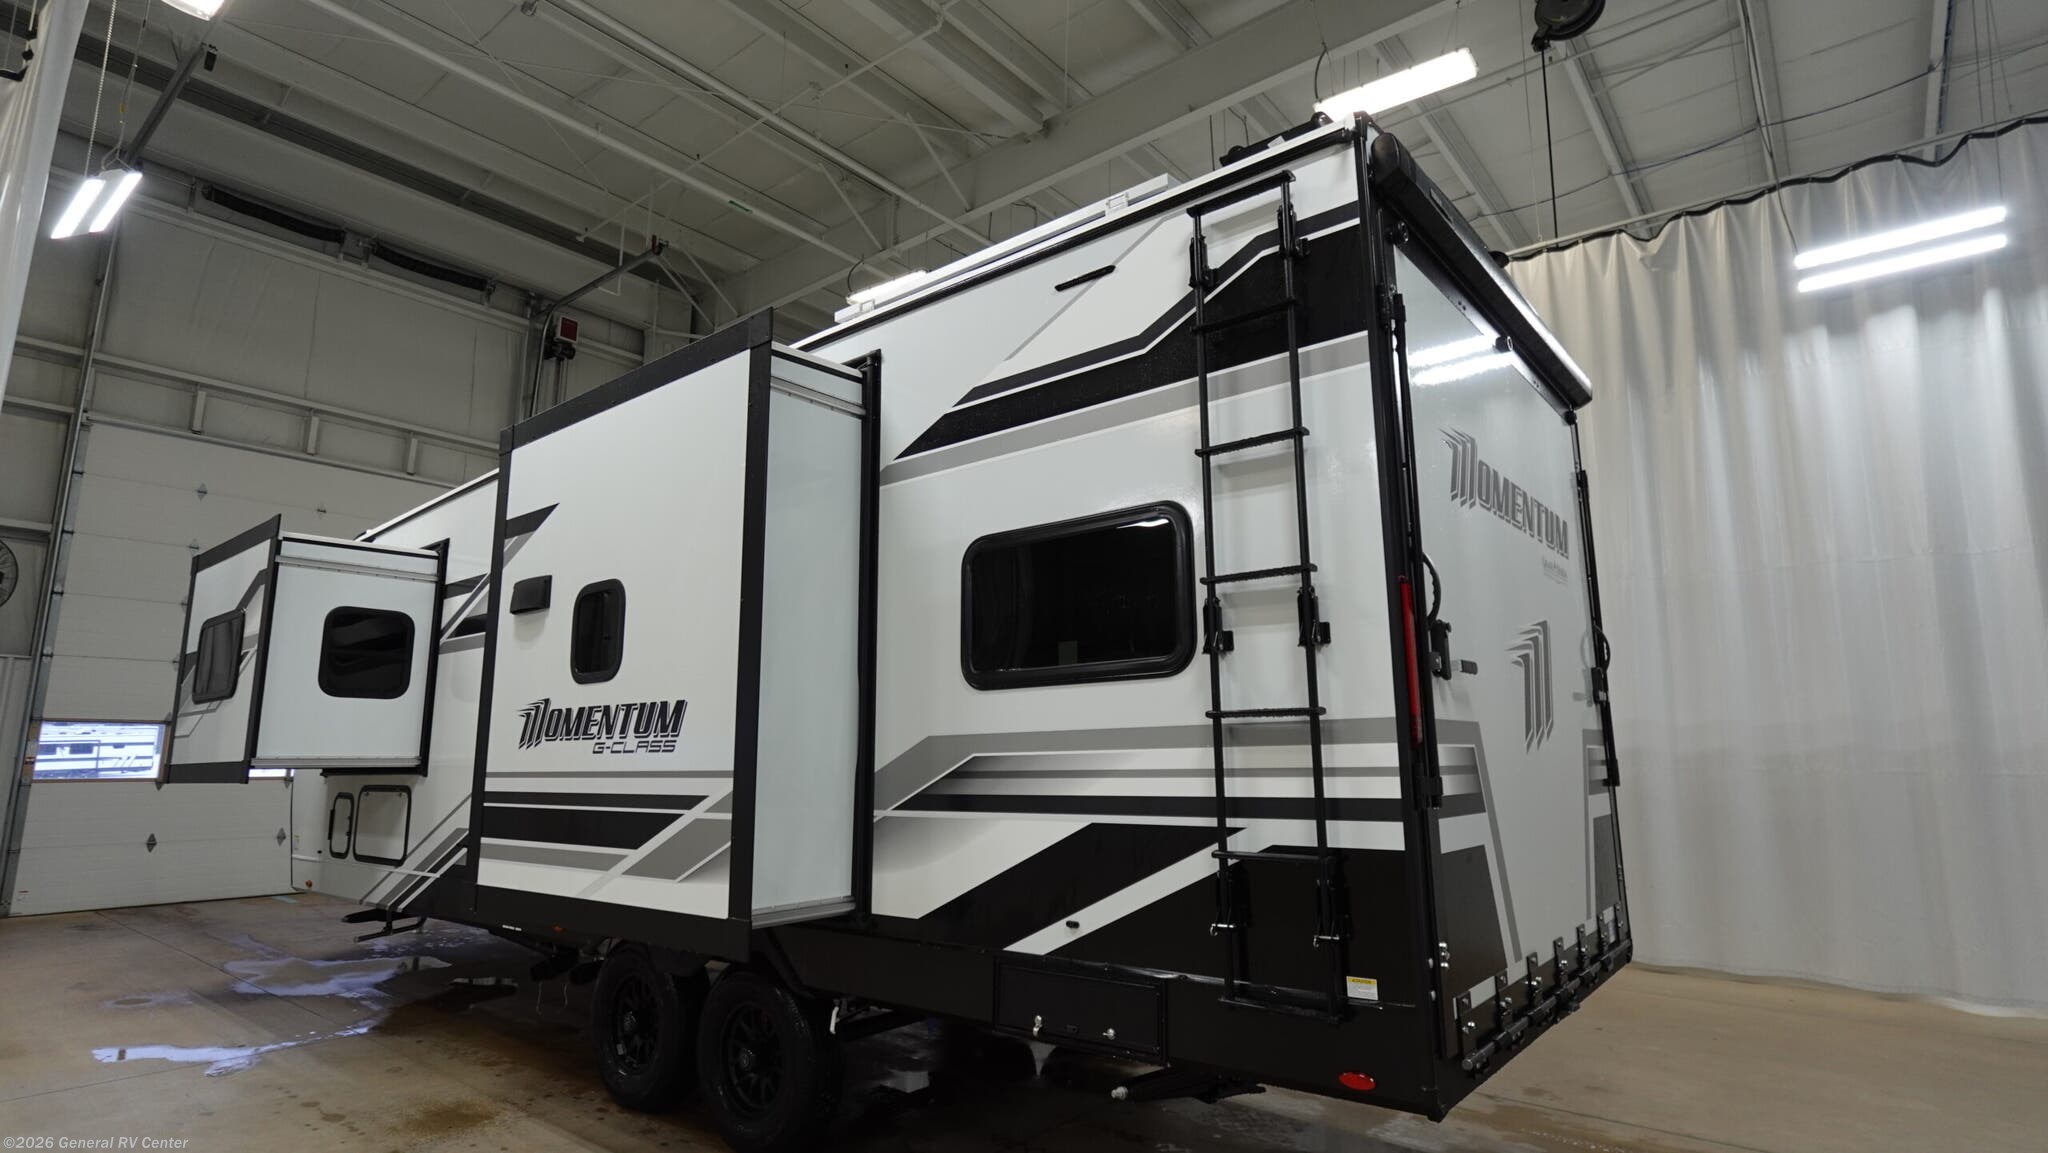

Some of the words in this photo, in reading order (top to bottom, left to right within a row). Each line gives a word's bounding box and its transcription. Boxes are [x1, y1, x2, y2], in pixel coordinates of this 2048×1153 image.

[1439, 427, 1570, 560] MOMENTUM
[517, 698, 688, 750] MOMENTUM
[592, 740, 677, 754] G-CLASS
